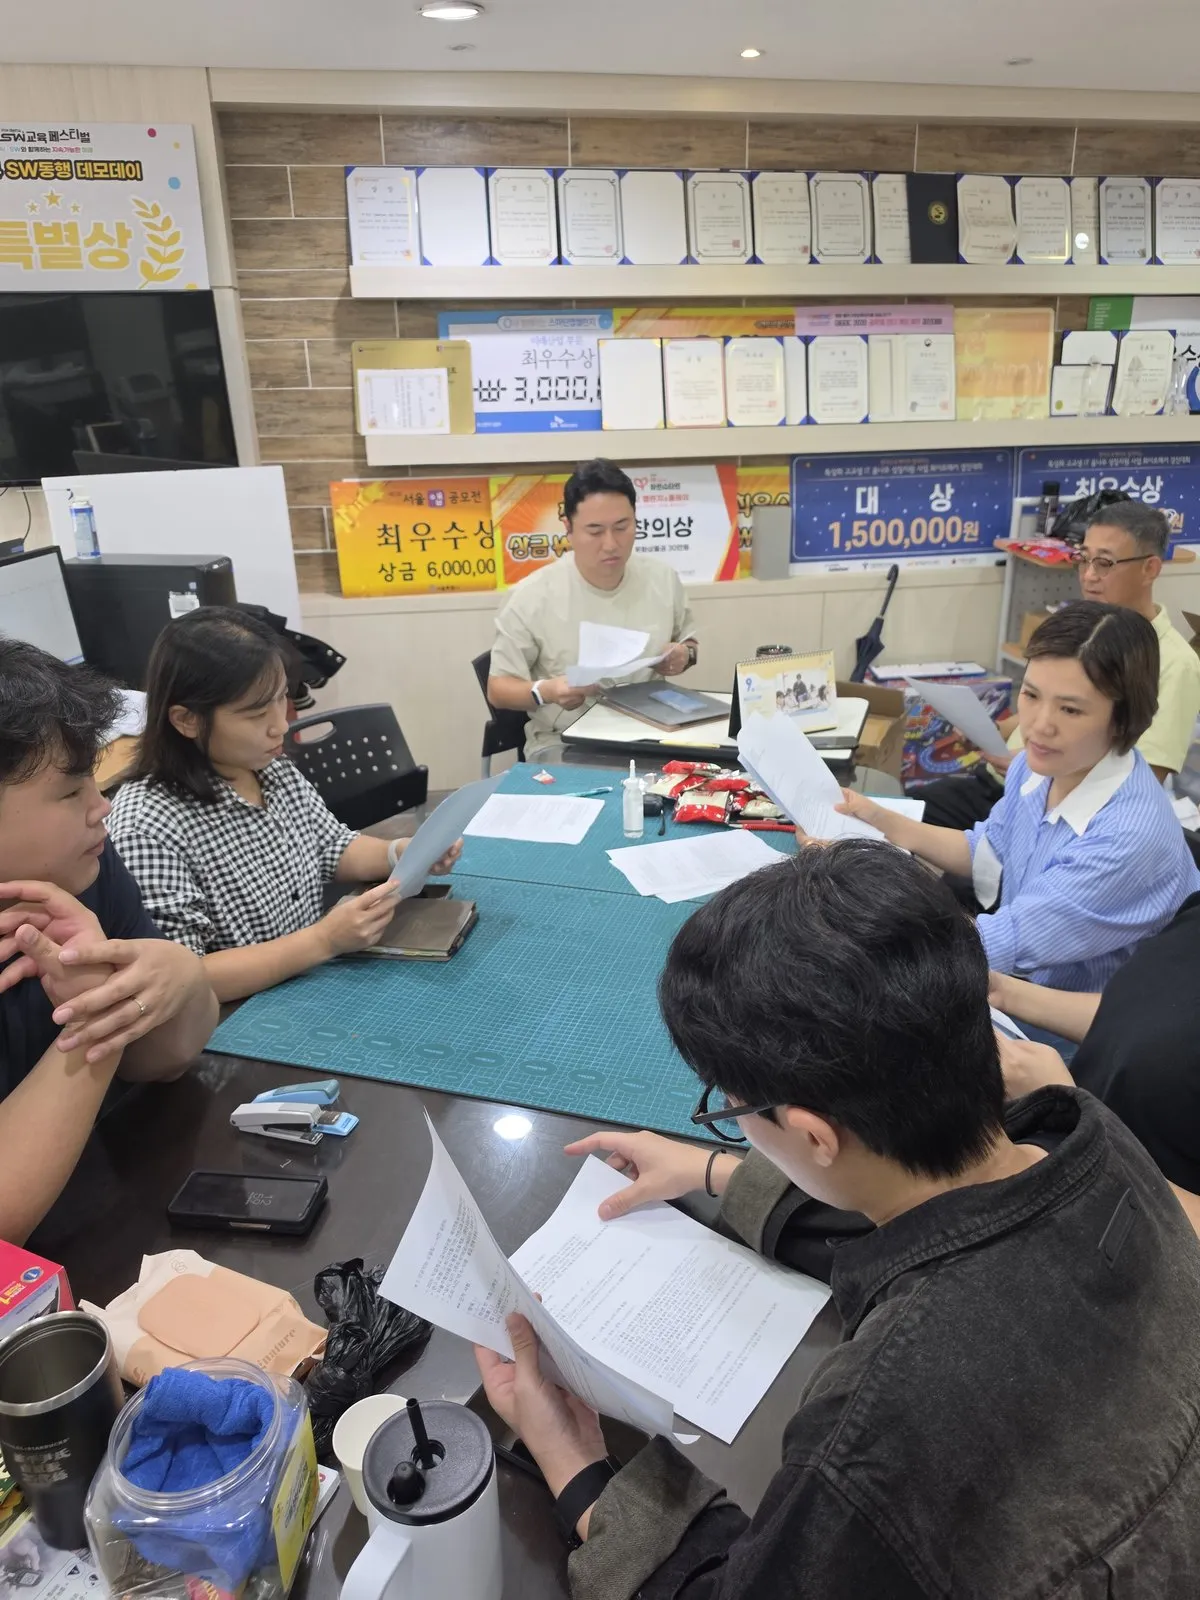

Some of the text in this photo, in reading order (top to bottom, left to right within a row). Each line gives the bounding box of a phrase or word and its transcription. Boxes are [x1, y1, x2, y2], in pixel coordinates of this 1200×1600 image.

[49, 128, 91, 144] 페스티벌
[5, 161, 142, 180] SW동행 데모데이
[0, 220, 133, 271] 특별상
[521, 348, 596, 370] 최우수상
[514, 376, 601, 404] 3,000,
[404, 492, 425, 506] 서울
[449, 490, 482, 505] 공모전
[855, 482, 955, 515] 대 상
[635, 516, 694, 540] 창의상
[828, 515, 980, 552] 1,500,000원
[508, 534, 549, 559] 상금
[378, 562, 417, 582] 상금
